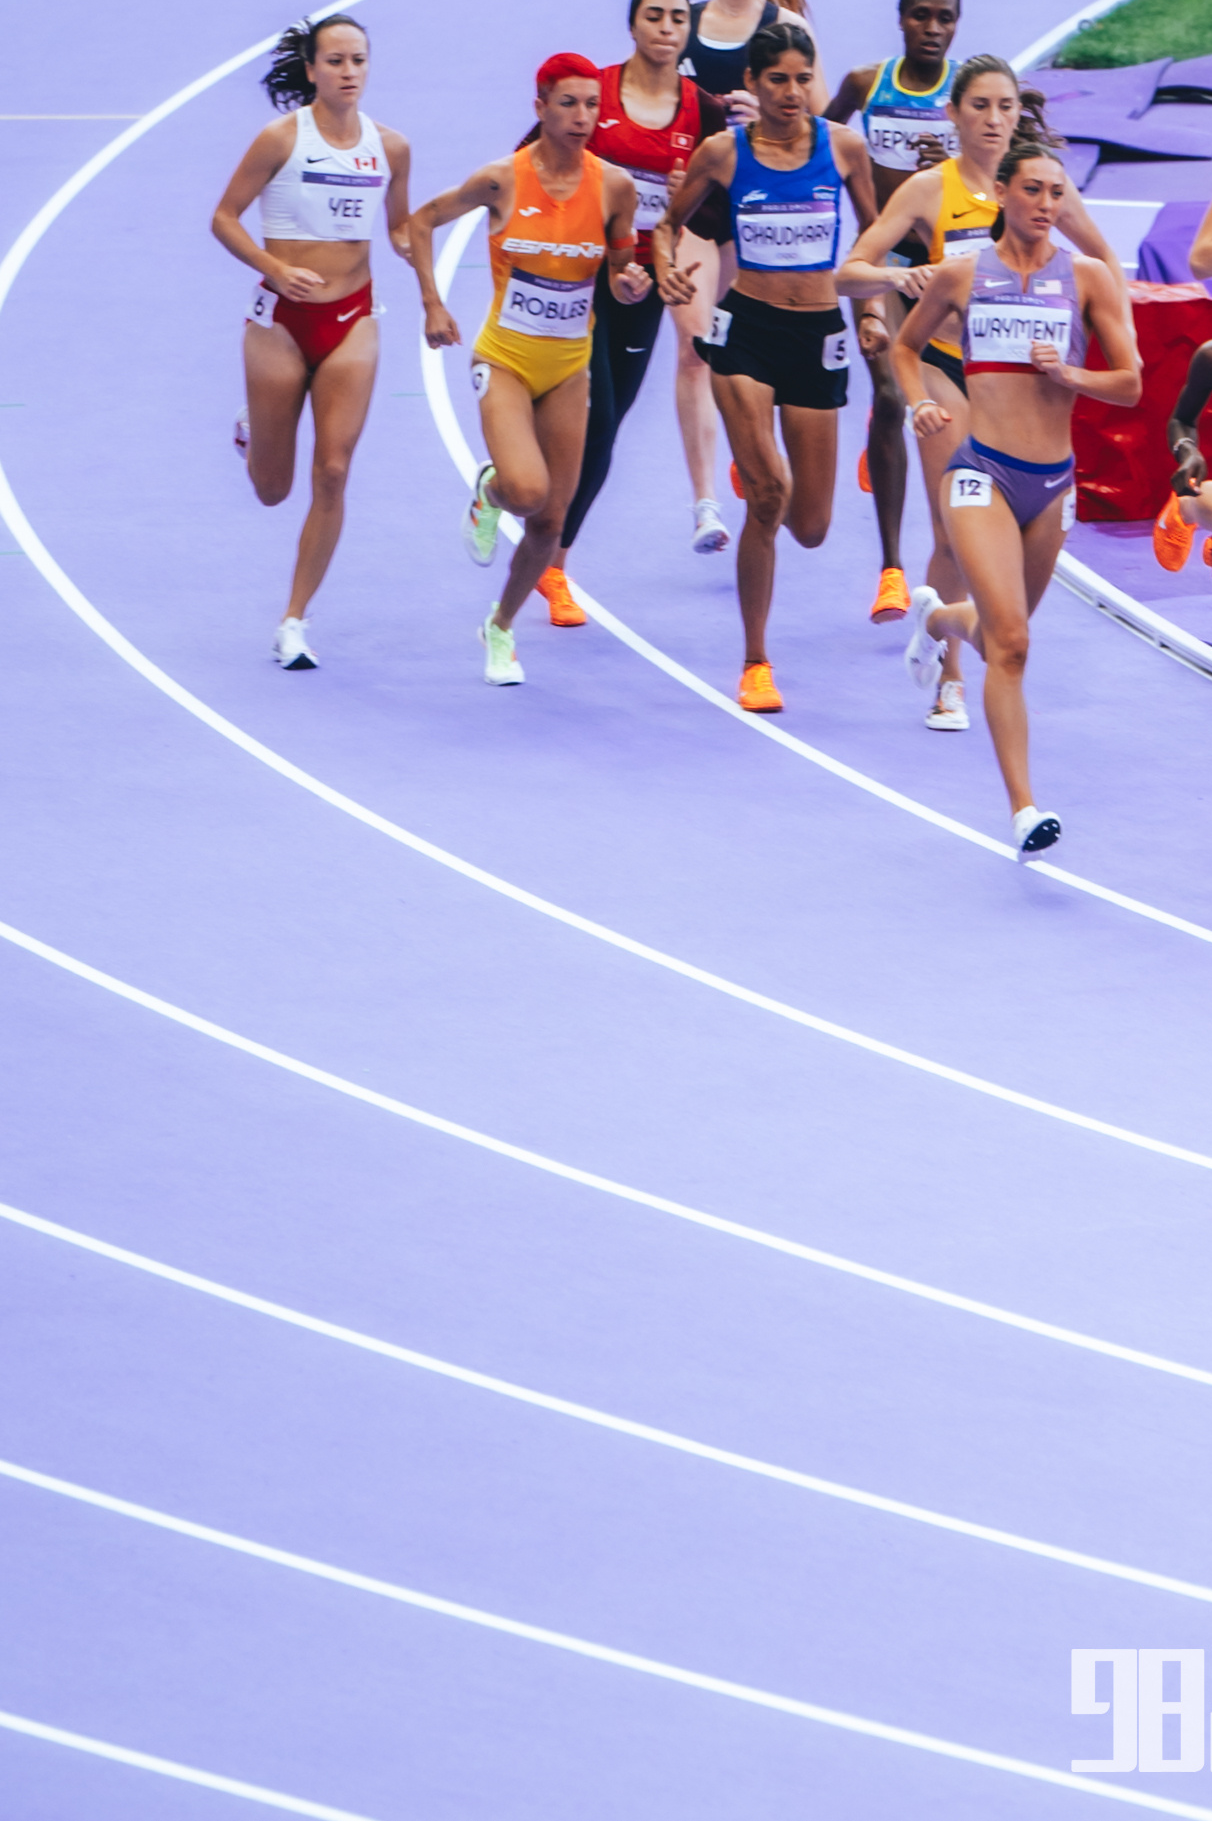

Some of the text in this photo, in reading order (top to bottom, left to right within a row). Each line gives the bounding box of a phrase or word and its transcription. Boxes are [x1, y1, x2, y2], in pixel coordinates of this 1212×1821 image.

[328, 197, 364, 218] YEE
[741, 224, 832, 247] CHAUDHARY
[254, 295, 265, 317] 6
[510, 291, 589, 321] ROBLES
[972, 317, 1068, 343] WAYMENT
[834, 339, 846, 362] 5
[958, 478, 981, 497] 12
